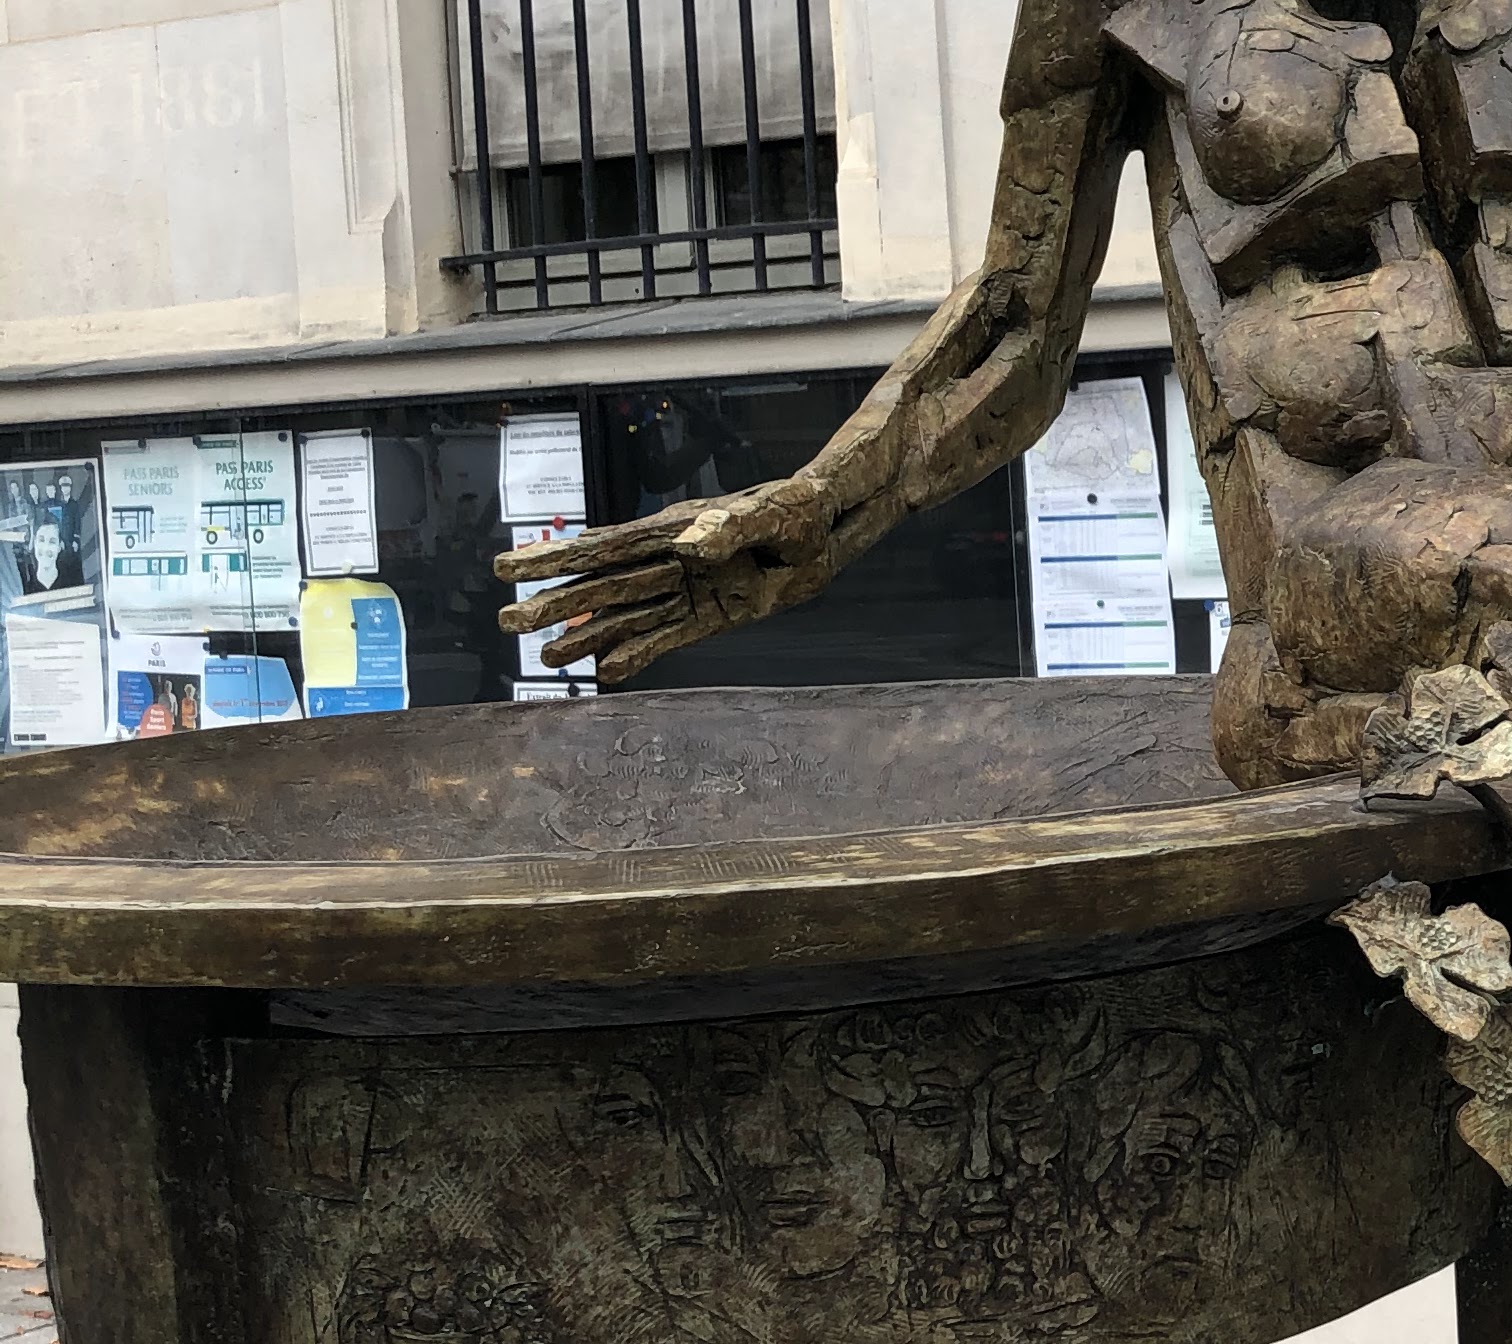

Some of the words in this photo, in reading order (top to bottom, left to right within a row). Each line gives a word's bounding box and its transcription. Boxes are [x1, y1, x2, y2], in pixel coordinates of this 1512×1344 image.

[124, 467, 147, 481] PASS
[149, 465, 180, 480] PARIS
[215, 460, 238, 475] PASS
[240, 459, 274, 474] PARIS
[128, 482, 174, 496] SENIORS
[148, 659, 166, 667] PARIS
